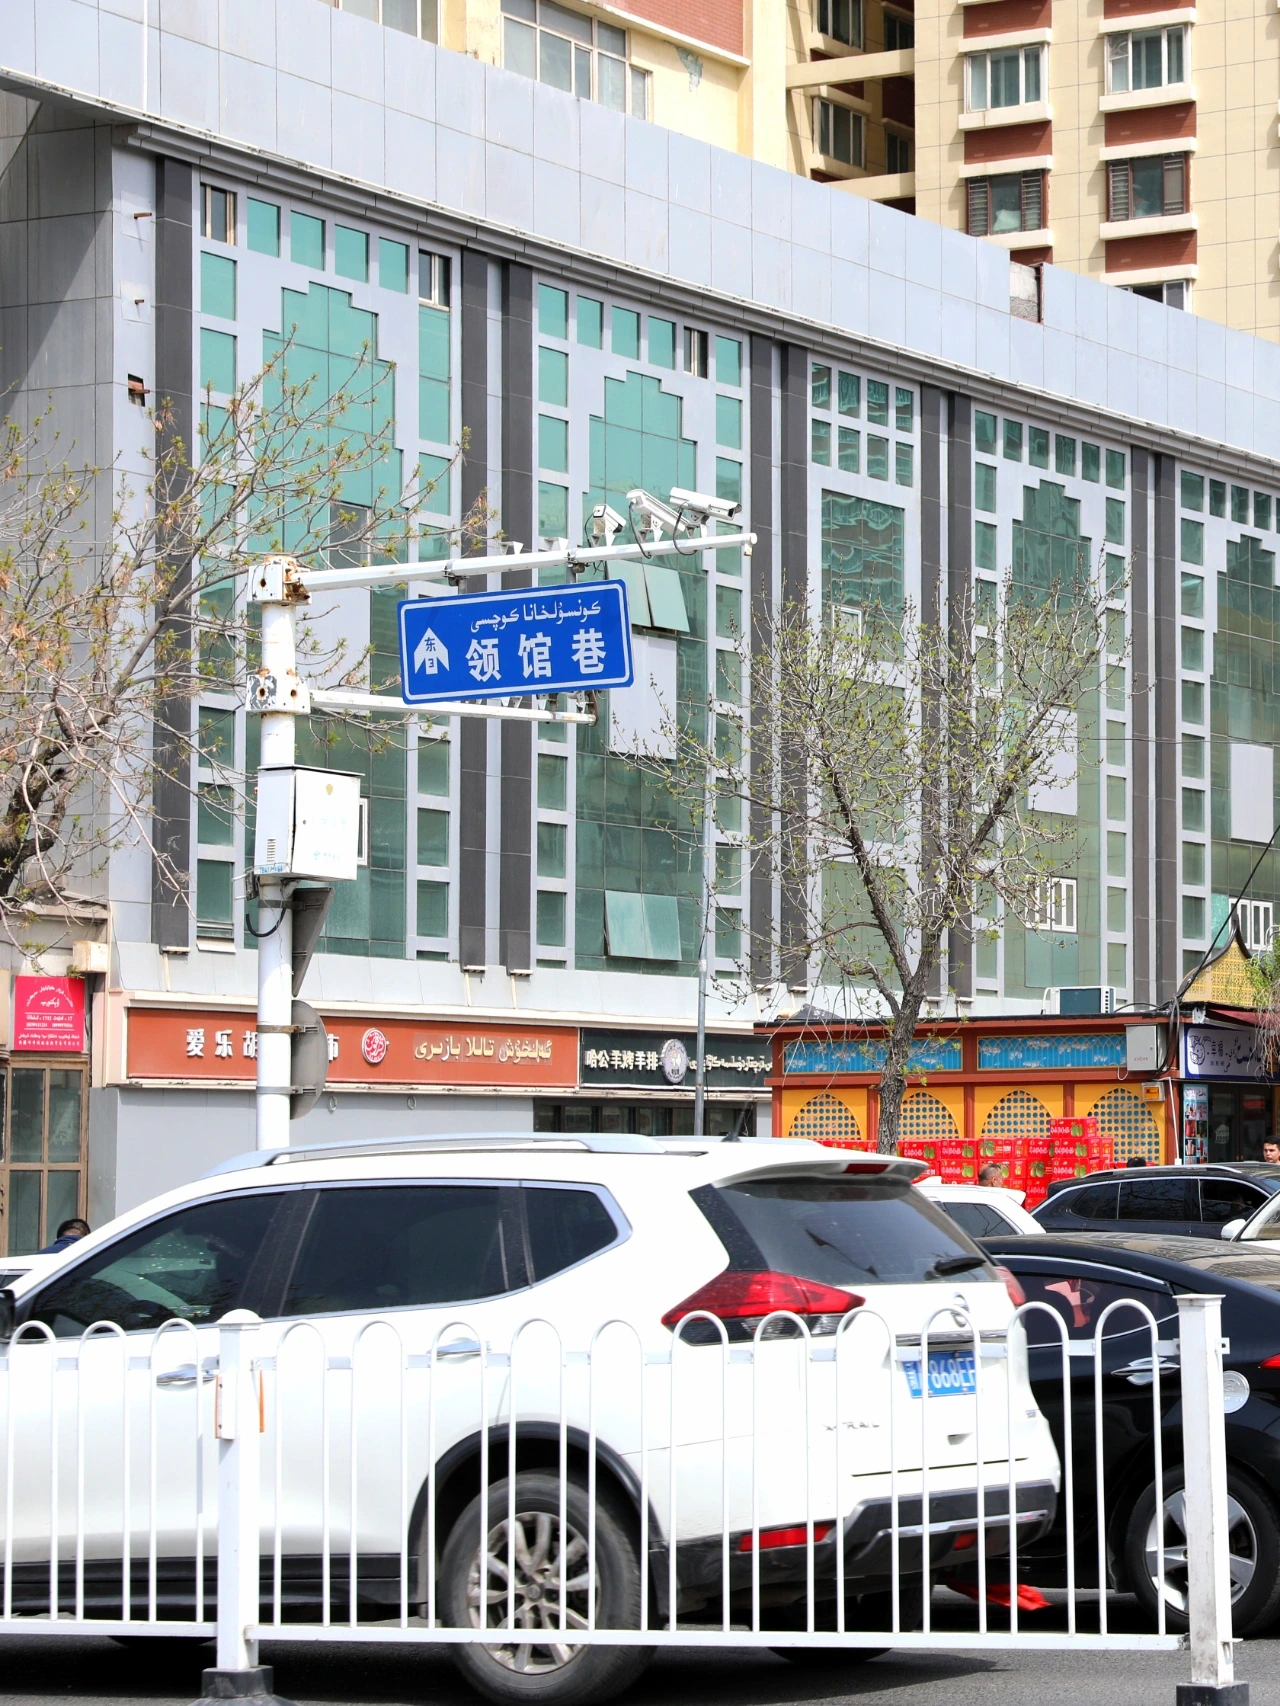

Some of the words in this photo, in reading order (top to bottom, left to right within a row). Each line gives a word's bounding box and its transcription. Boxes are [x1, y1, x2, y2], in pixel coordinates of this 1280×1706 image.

[424, 636, 437, 652] 东
[465, 627, 606, 682] 领馆巷
[584, 1048, 659, 1071] 哈公羊烤羊排
